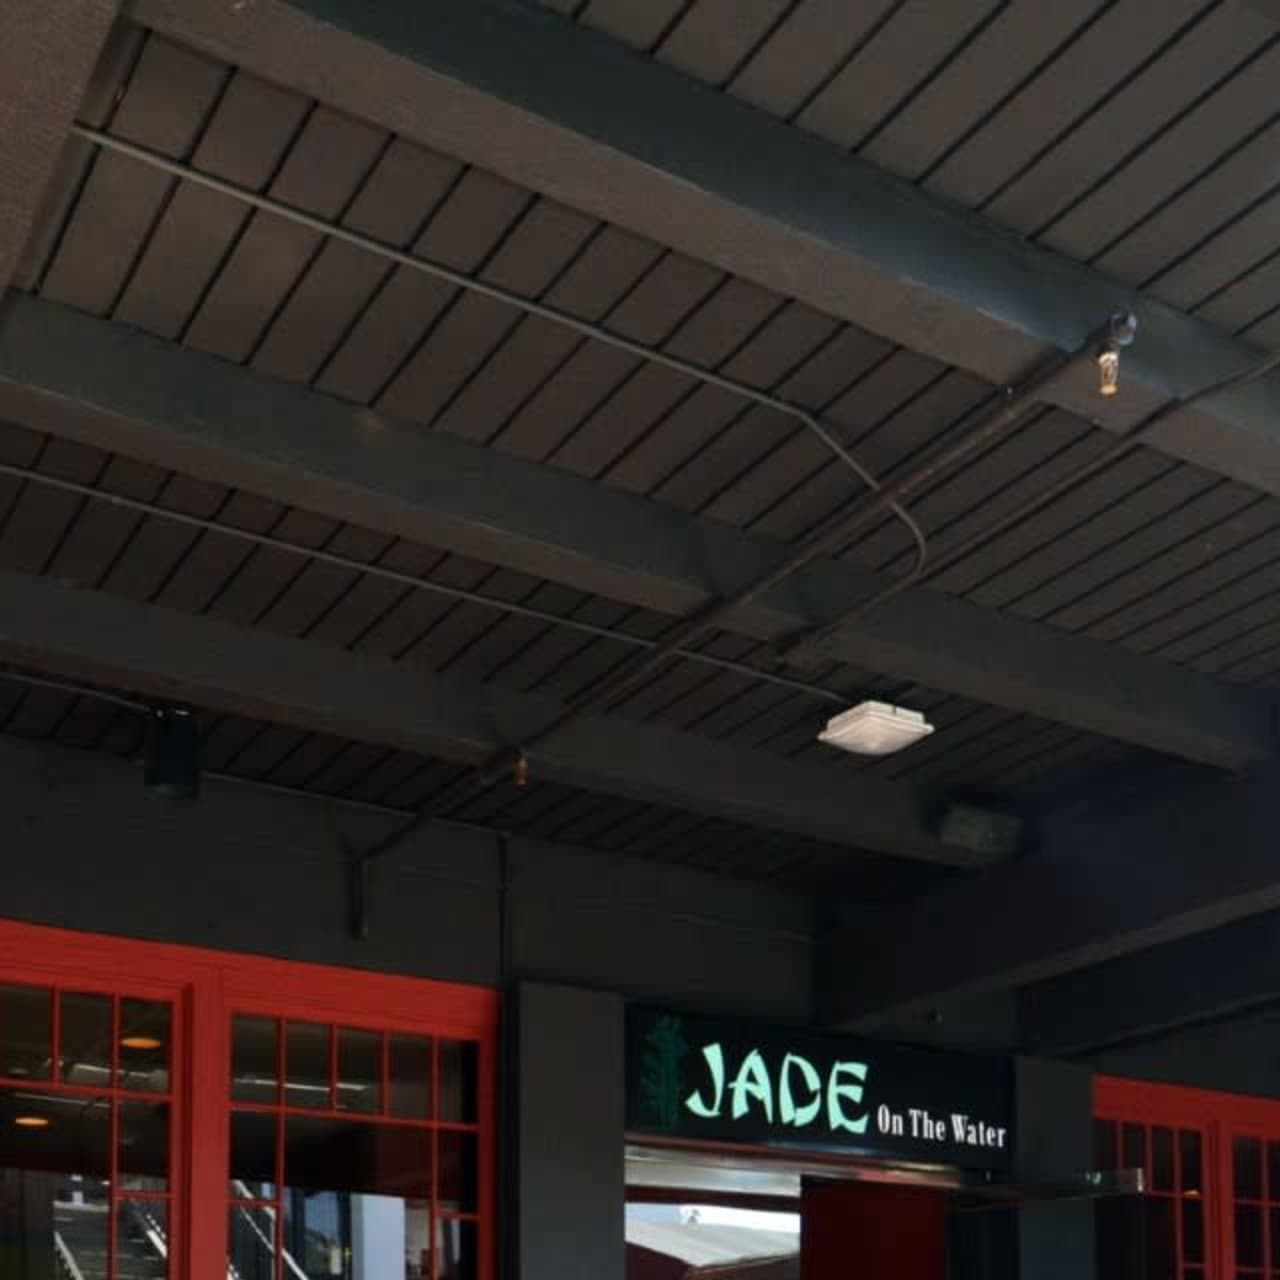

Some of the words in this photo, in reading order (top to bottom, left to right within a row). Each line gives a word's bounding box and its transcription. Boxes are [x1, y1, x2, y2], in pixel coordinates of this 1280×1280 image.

[685, 1042, 869, 1134] JADE
[877, 1104, 904, 1136] On
[908, 1108, 946, 1141] The
[951, 1114, 1007, 1148] Water
